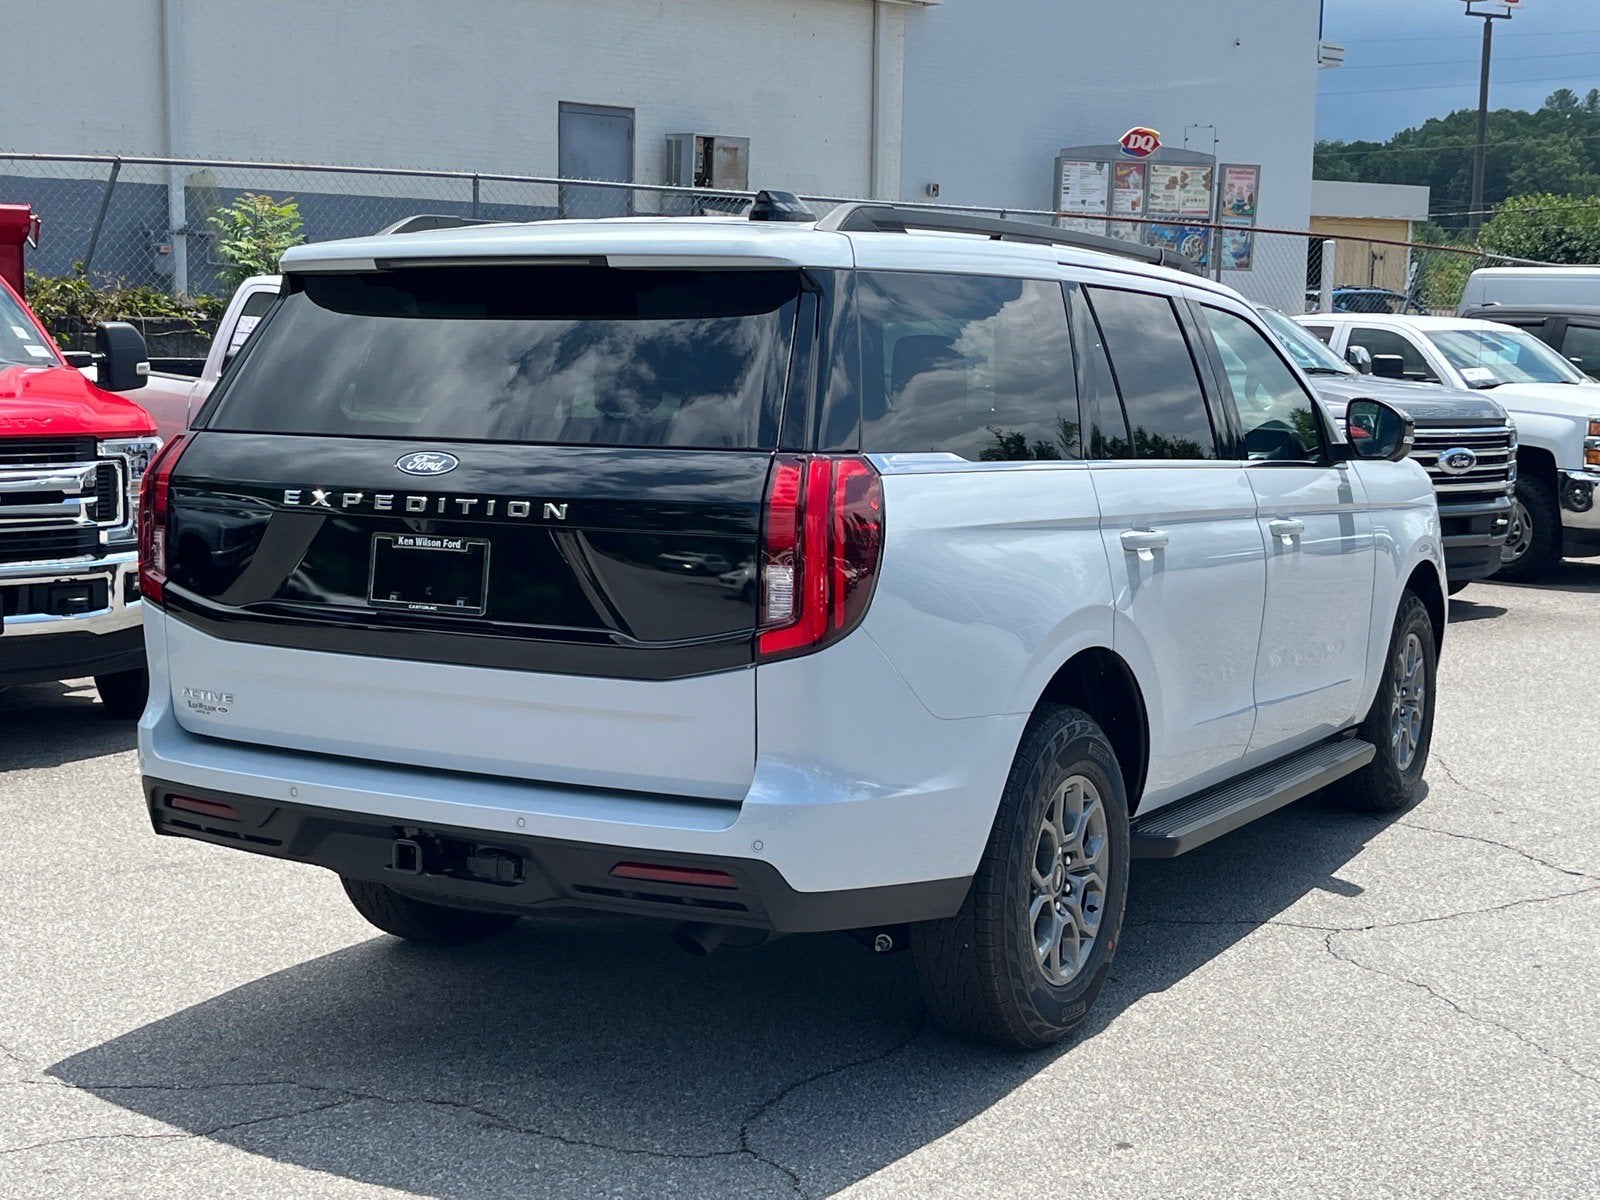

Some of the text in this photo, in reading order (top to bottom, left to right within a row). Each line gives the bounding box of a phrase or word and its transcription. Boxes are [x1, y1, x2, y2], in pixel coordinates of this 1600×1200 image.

[1127, 134, 1155, 152] DQ
[407, 453, 446, 472] Ford
[283, 489, 569, 520] EXPEDITION
[398, 536, 461, 549] Ken Wilson Ford
[182, 687, 233, 704] ACTIVE
